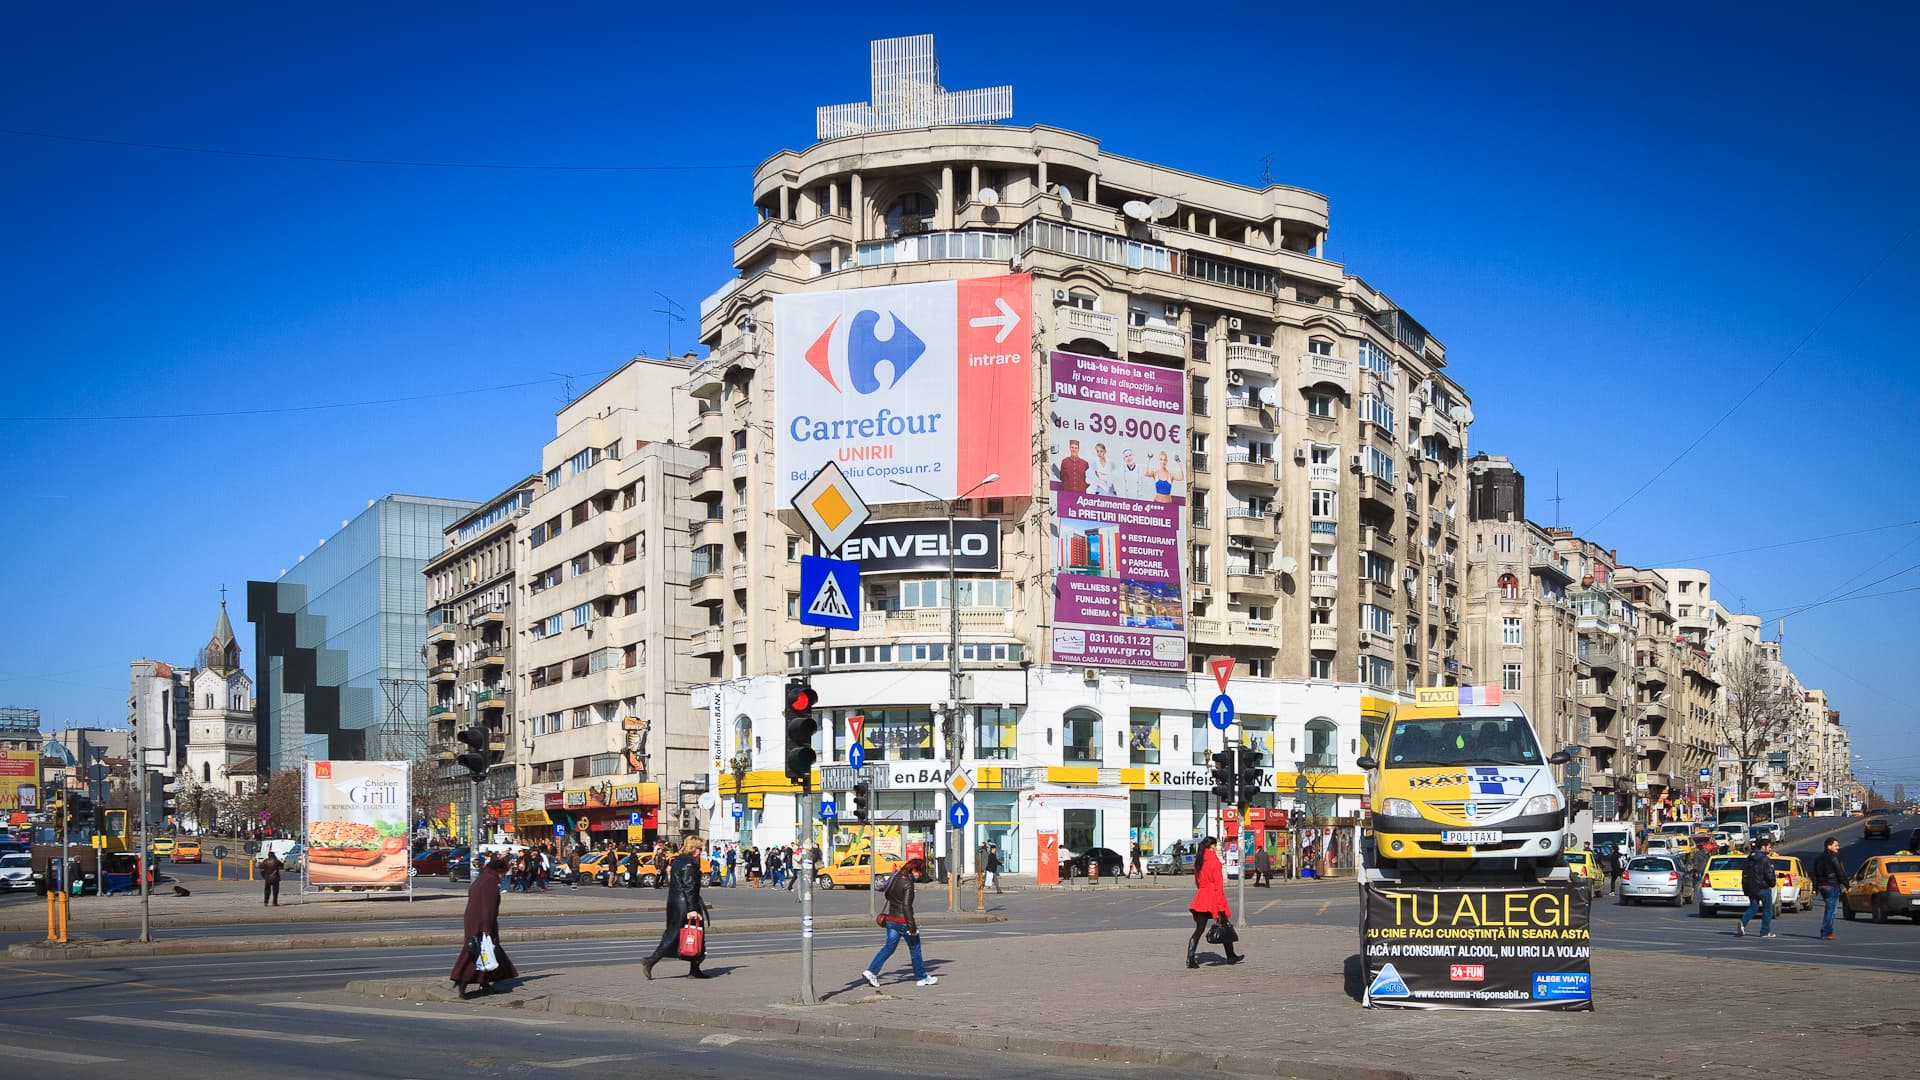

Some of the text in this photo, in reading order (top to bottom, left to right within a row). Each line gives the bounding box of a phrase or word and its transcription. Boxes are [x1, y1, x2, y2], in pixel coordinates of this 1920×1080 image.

[969, 352, 1021, 367] intrare
[1111, 365, 1131, 375] bine
[1133, 368, 1142, 378] la
[1082, 374, 1095, 382] vor
[1096, 376, 1108, 385] sta
[1109, 377, 1117, 387] la
[1055, 381, 1180, 411] RIN Grand Residence
[790, 408, 942, 442] Carrefour
[1074, 418, 1085, 431] la
[1089, 413, 1181, 444] 39.900€
[838, 444, 893, 462] UNIRII
[791, 471, 810, 482] Bd.
[866, 465, 913, 479] Coposu
[915, 464, 931, 474] nr.
[933, 461, 942, 473] 2
[1076, 495, 1131, 512] Apartamente
[1132, 502, 1143, 512] de
[1068, 507, 1077, 518] la
[1117, 513, 1172, 528] INCREDIBILE
[1128, 534, 1176, 546] RESTAURANT
[1128, 547, 1165, 557] SECURITY
[1128, 558, 1163, 569] PARCARE
[1070, 581, 1110, 593] WELLNESS
[1075, 595, 1110, 605] FUNLAND
[1080, 607, 1110, 617] CINEMA
[1089, 632, 1151, 646] 031.106.11.22
[1089, 644, 1151, 657] www.rgr.ro
[1422, 692, 1453, 702] TAXI
[365, 779, 399, 787] Chicken
[349, 785, 396, 804] Grill
[631, 812, 639, 824] P
[1450, 831, 1497, 841] POLITAXI
[1386, 893, 1569, 926] TU ALEGI
[1382, 928, 1407, 938] CINE
[1409, 928, 1434, 938] FACI
[1508, 927, 1520, 938] ÎN
[1522, 929, 1559, 939] SEARA
[1560, 929, 1590, 939] ASTA
[1390, 944, 1401, 956] AI
[1402, 945, 1455, 957] CONSUMAT
[1458, 945, 1499, 959] ALCOOL,
[1500, 946, 1515, 957] NU
[1516, 946, 1540, 957] URCI
[1542, 946, 1555, 957] LA
[1558, 946, 1590, 958] VOLAN
[1536, 975, 1561, 983] ALEGE
[1414, 989, 1530, 1000] www.consuma-responsabil.ro
